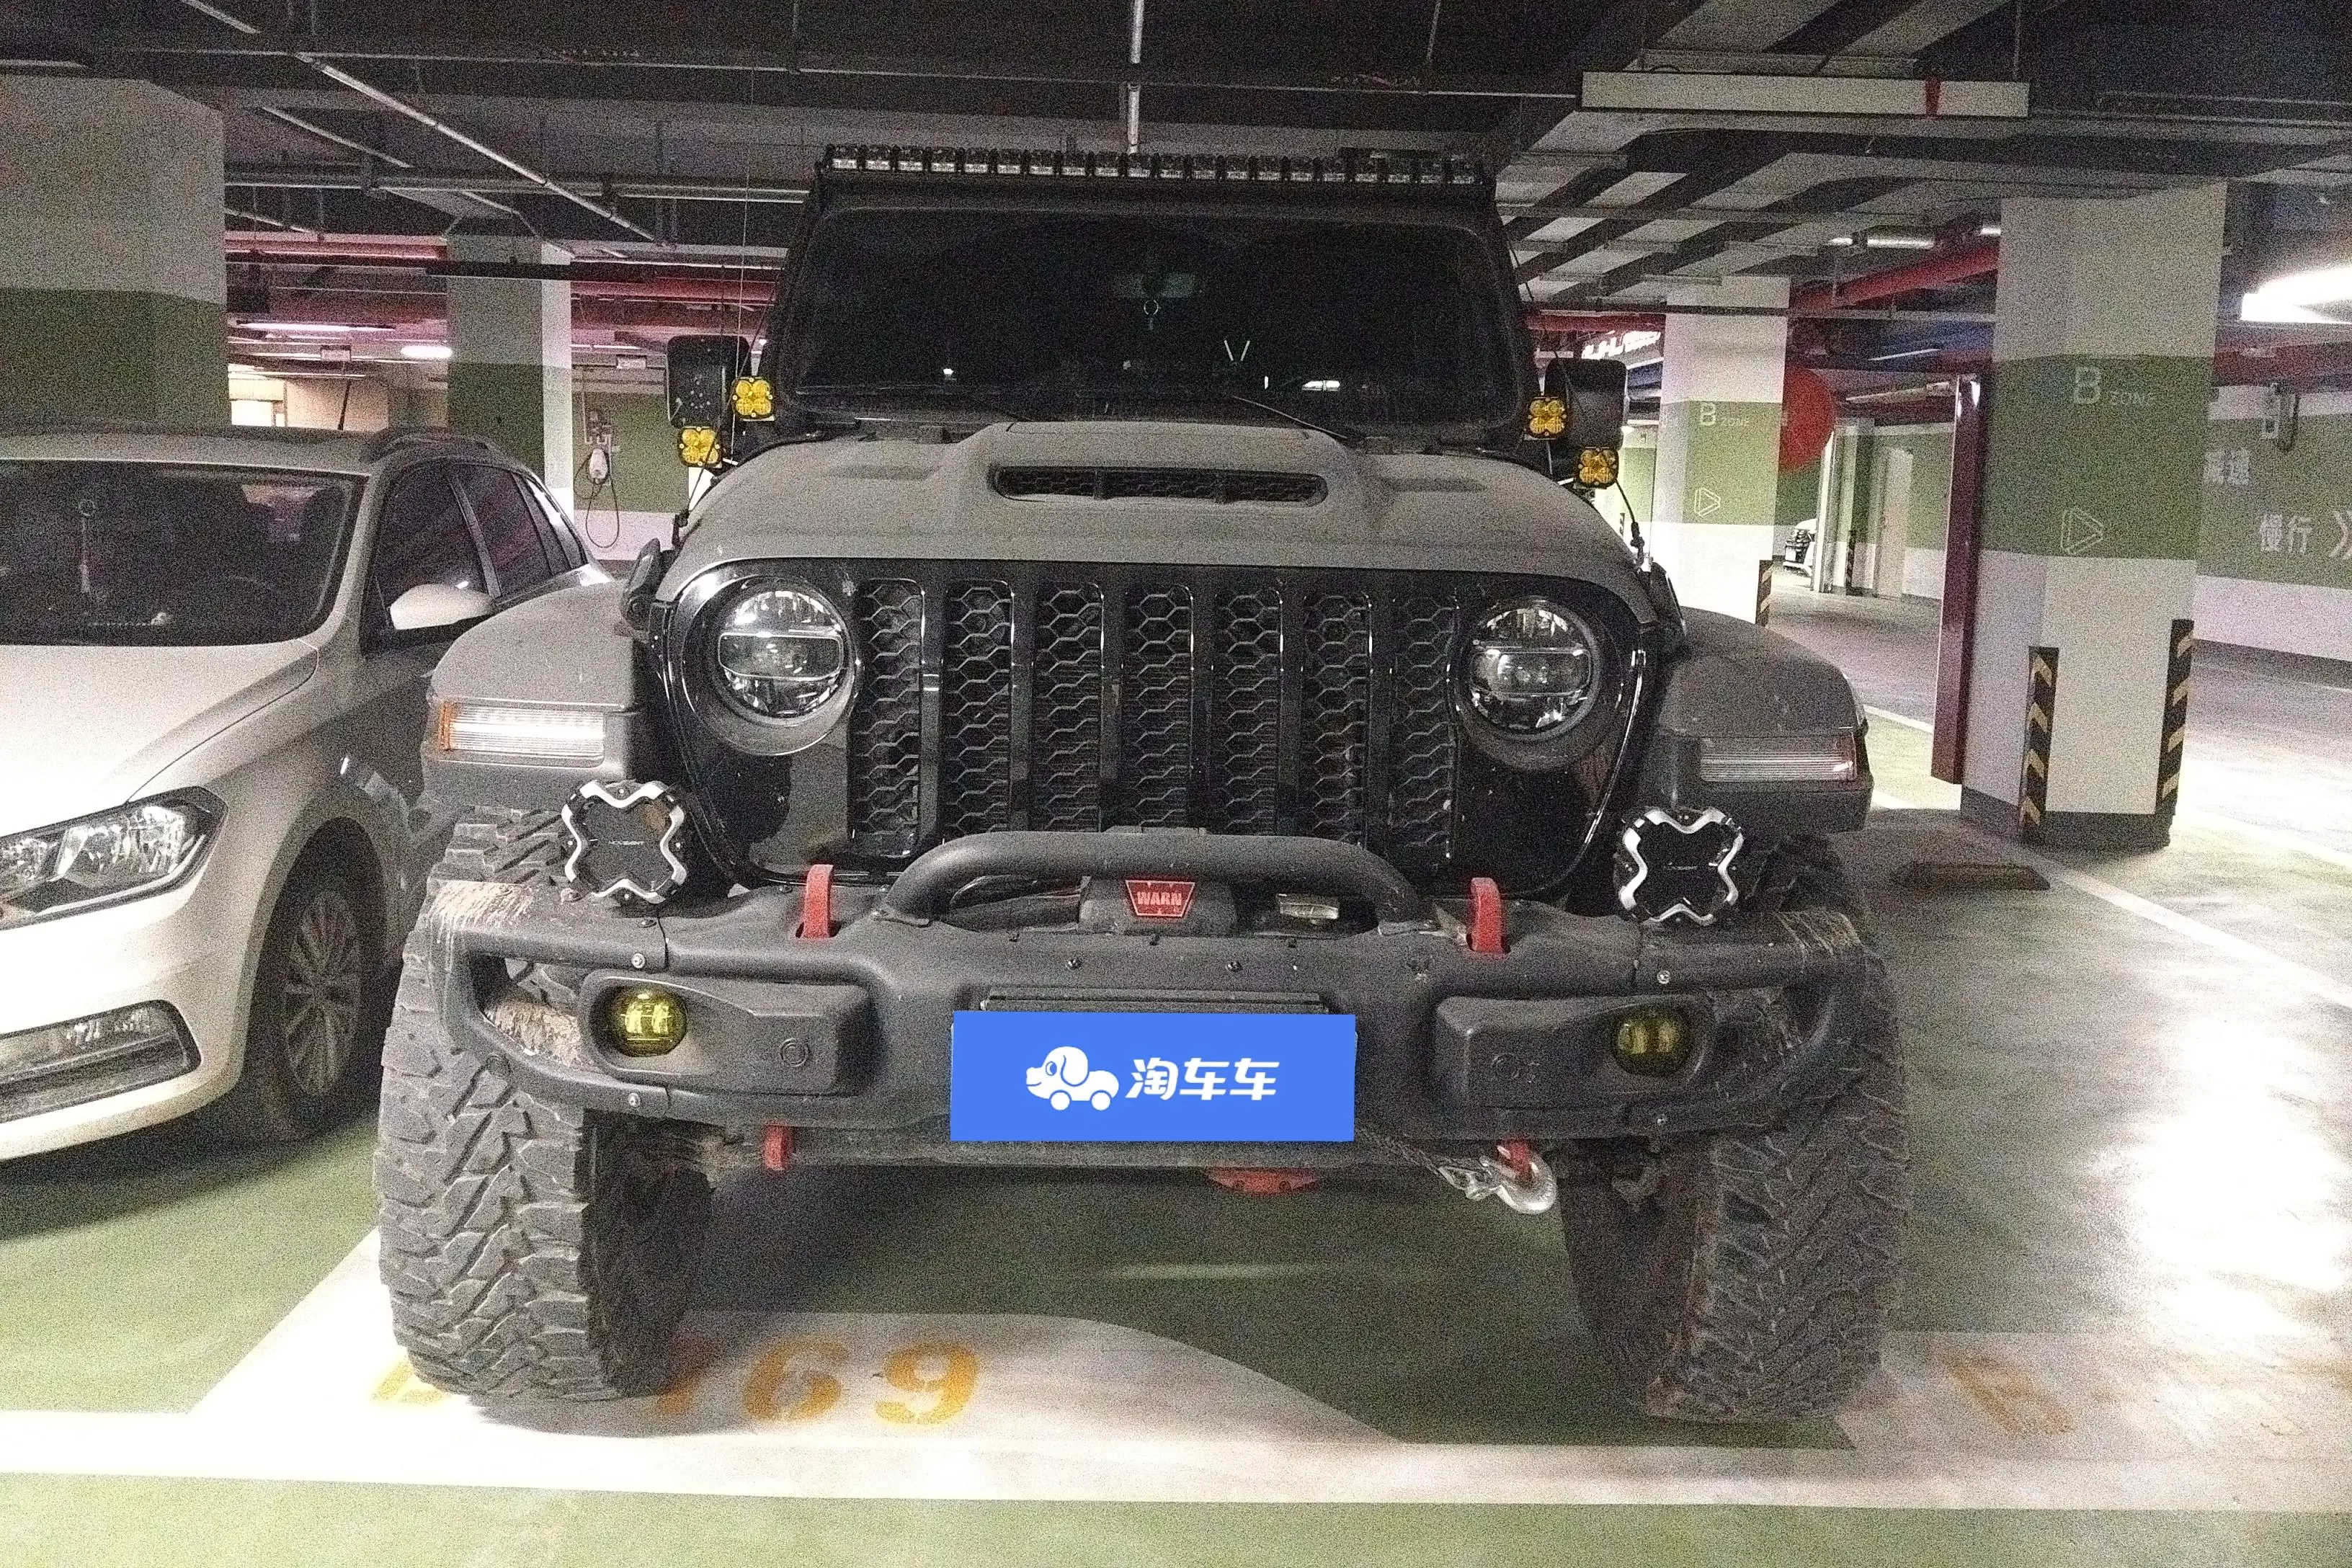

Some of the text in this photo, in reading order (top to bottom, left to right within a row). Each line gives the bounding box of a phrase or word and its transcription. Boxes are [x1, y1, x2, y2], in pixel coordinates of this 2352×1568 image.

[2073, 366, 2102, 404] B
[1700, 402, 1716, 426] B
[2259, 513, 2312, 554] 慢行
[1136, 891, 1182, 906] WARN
